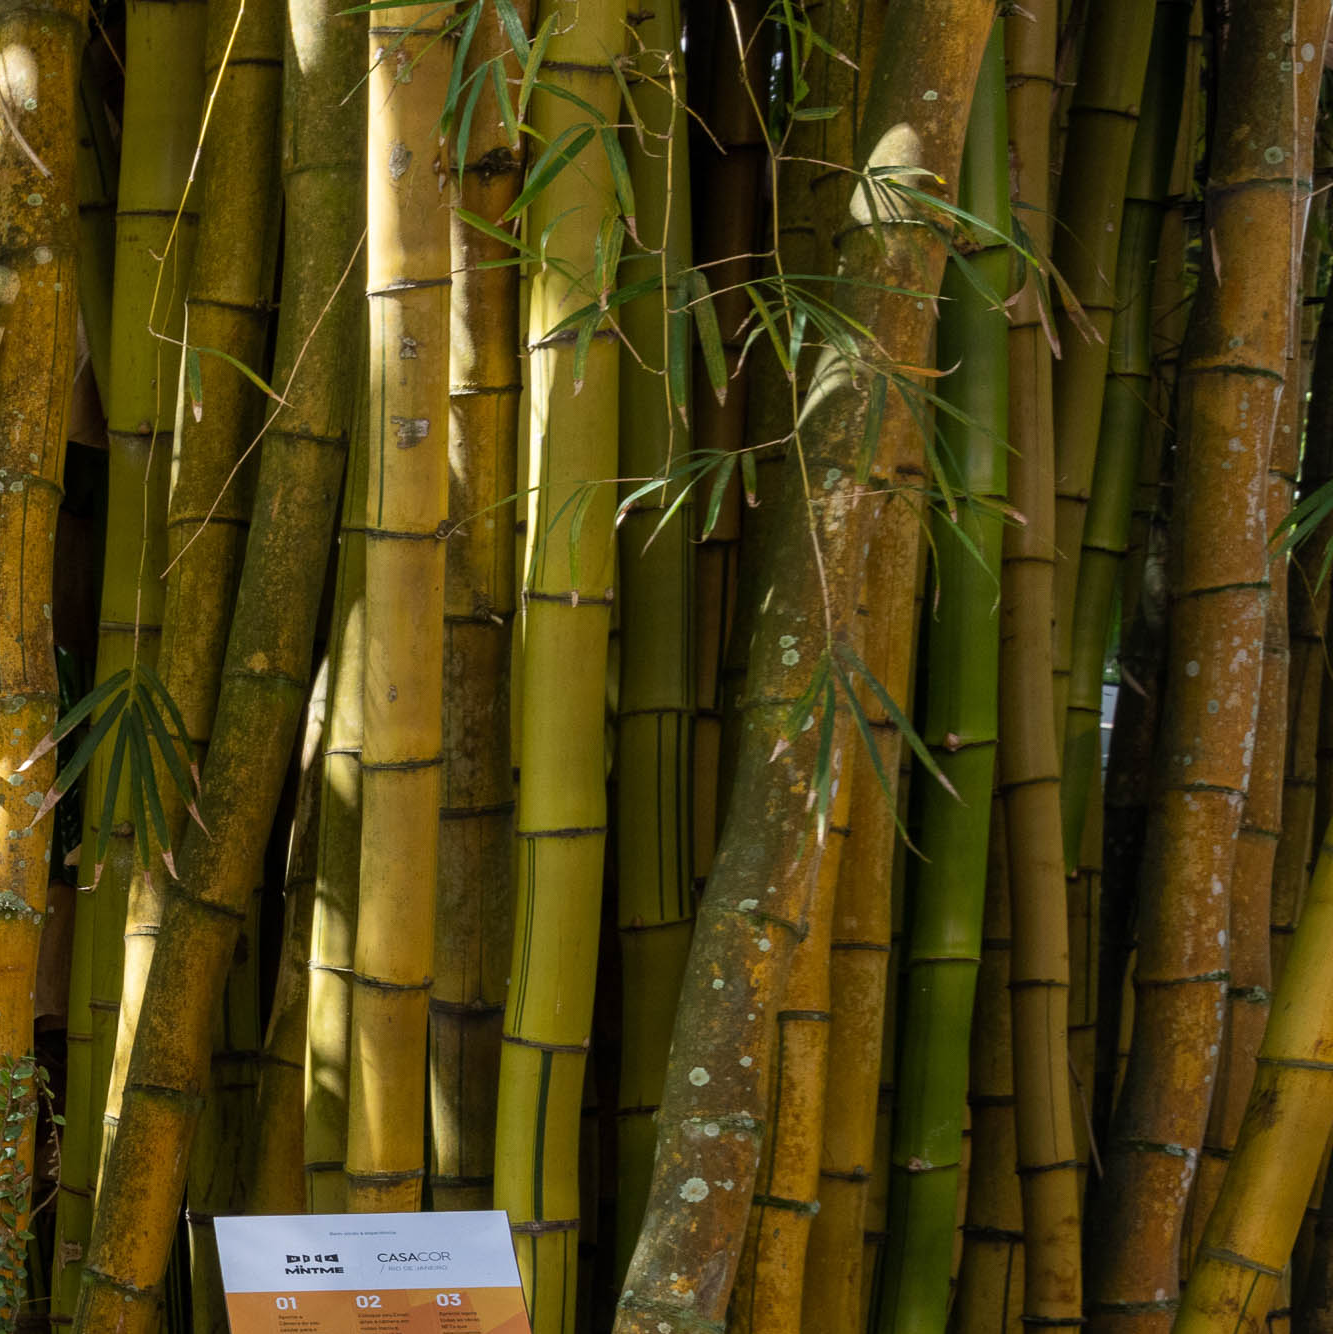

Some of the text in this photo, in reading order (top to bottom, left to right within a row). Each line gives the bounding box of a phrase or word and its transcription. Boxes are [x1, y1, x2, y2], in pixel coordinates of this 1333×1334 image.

[377, 1252, 451, 1262] CASACOR
[276, 1296, 297, 1310] 01
[356, 1295, 382, 1309] 02
[436, 1293, 461, 1306] 03
